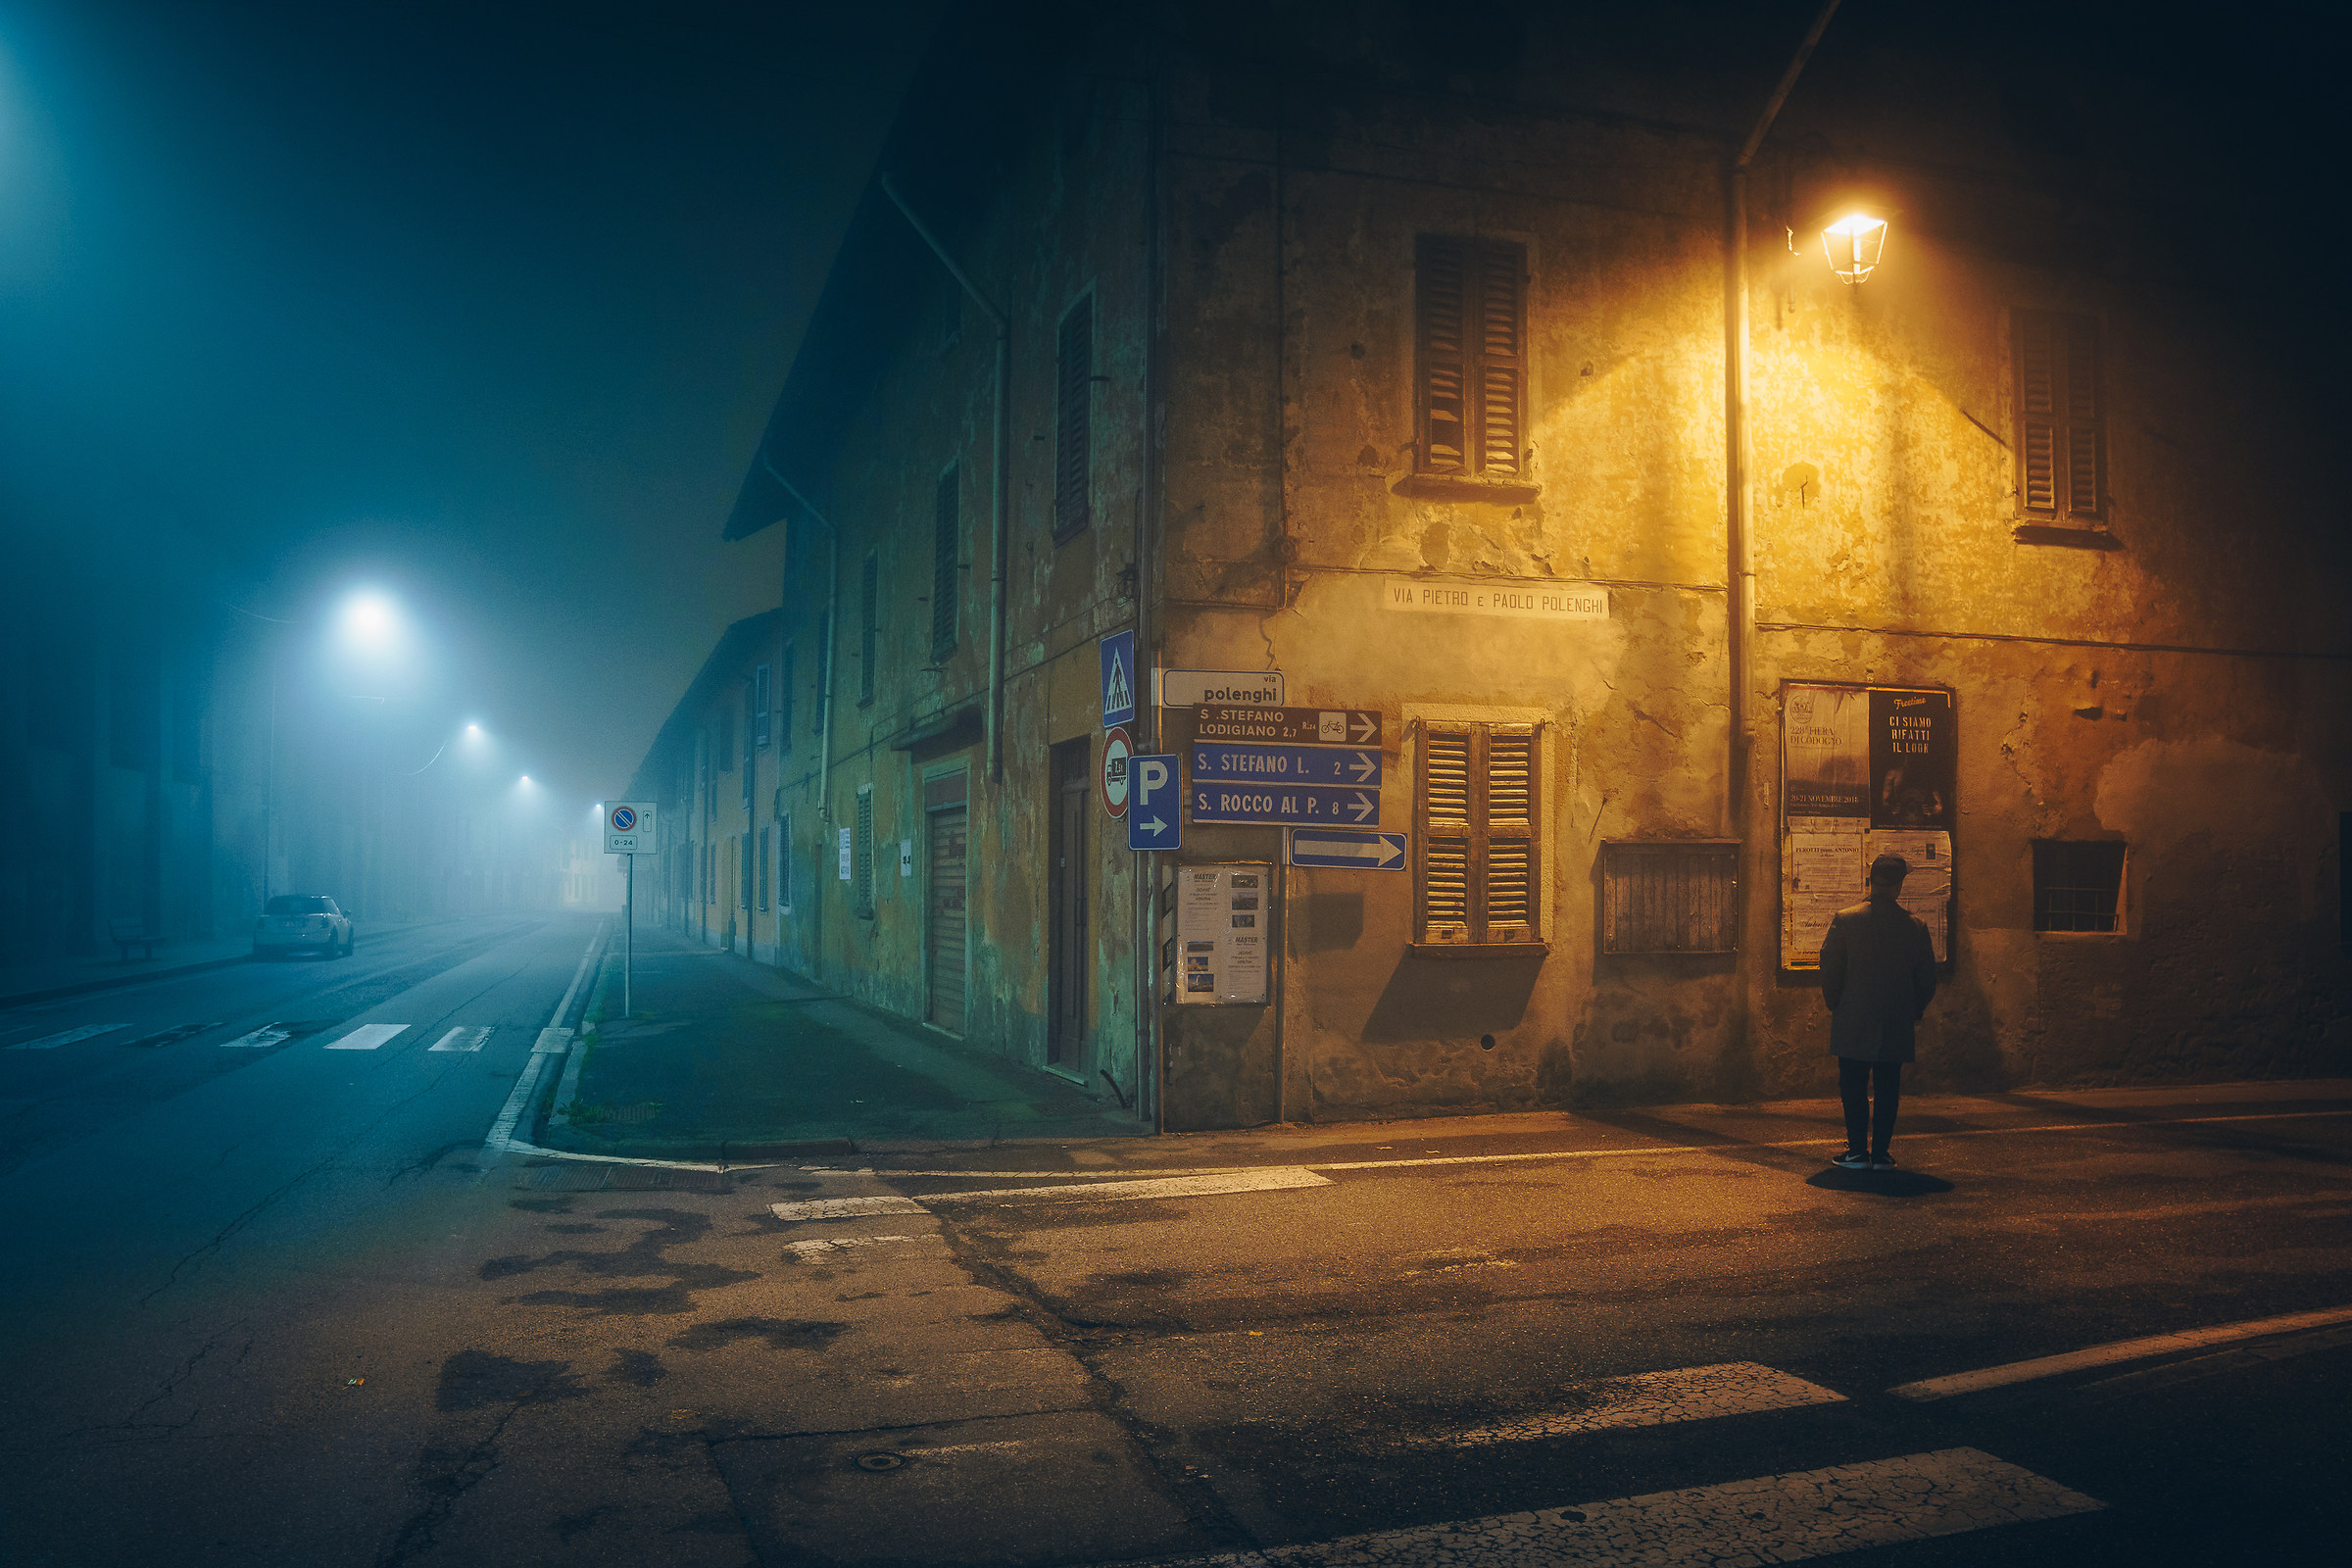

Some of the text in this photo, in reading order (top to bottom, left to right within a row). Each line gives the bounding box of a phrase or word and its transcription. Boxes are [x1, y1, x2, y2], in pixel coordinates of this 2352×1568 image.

[1394, 587, 1413, 604] VIA
[1423, 589, 1468, 606] PIETRO
[1493, 593, 1534, 610] PAOLO
[1542, 596, 1602, 613] POLENGHI
[1263, 674, 1277, 683] via
[1203, 686, 1277, 704] polenghi
[1889, 715, 1932, 728] CI SIAMO
[1200, 723, 1276, 737] LODIGIANO
[1809, 726, 1835, 736] FIERA
[1891, 729, 1930, 741] RIFATTI
[1789, 735, 1842, 746] DI CODOGNO
[1892, 742, 1929, 754] IL LOOK
[1198, 753, 1342, 775] S. STEFANO L. 2
[1139, 760, 1168, 806] P
[1198, 793, 1340, 815] S. ROCCO AL P. 8
[1807, 795, 1843, 804] NOVEMBRE
